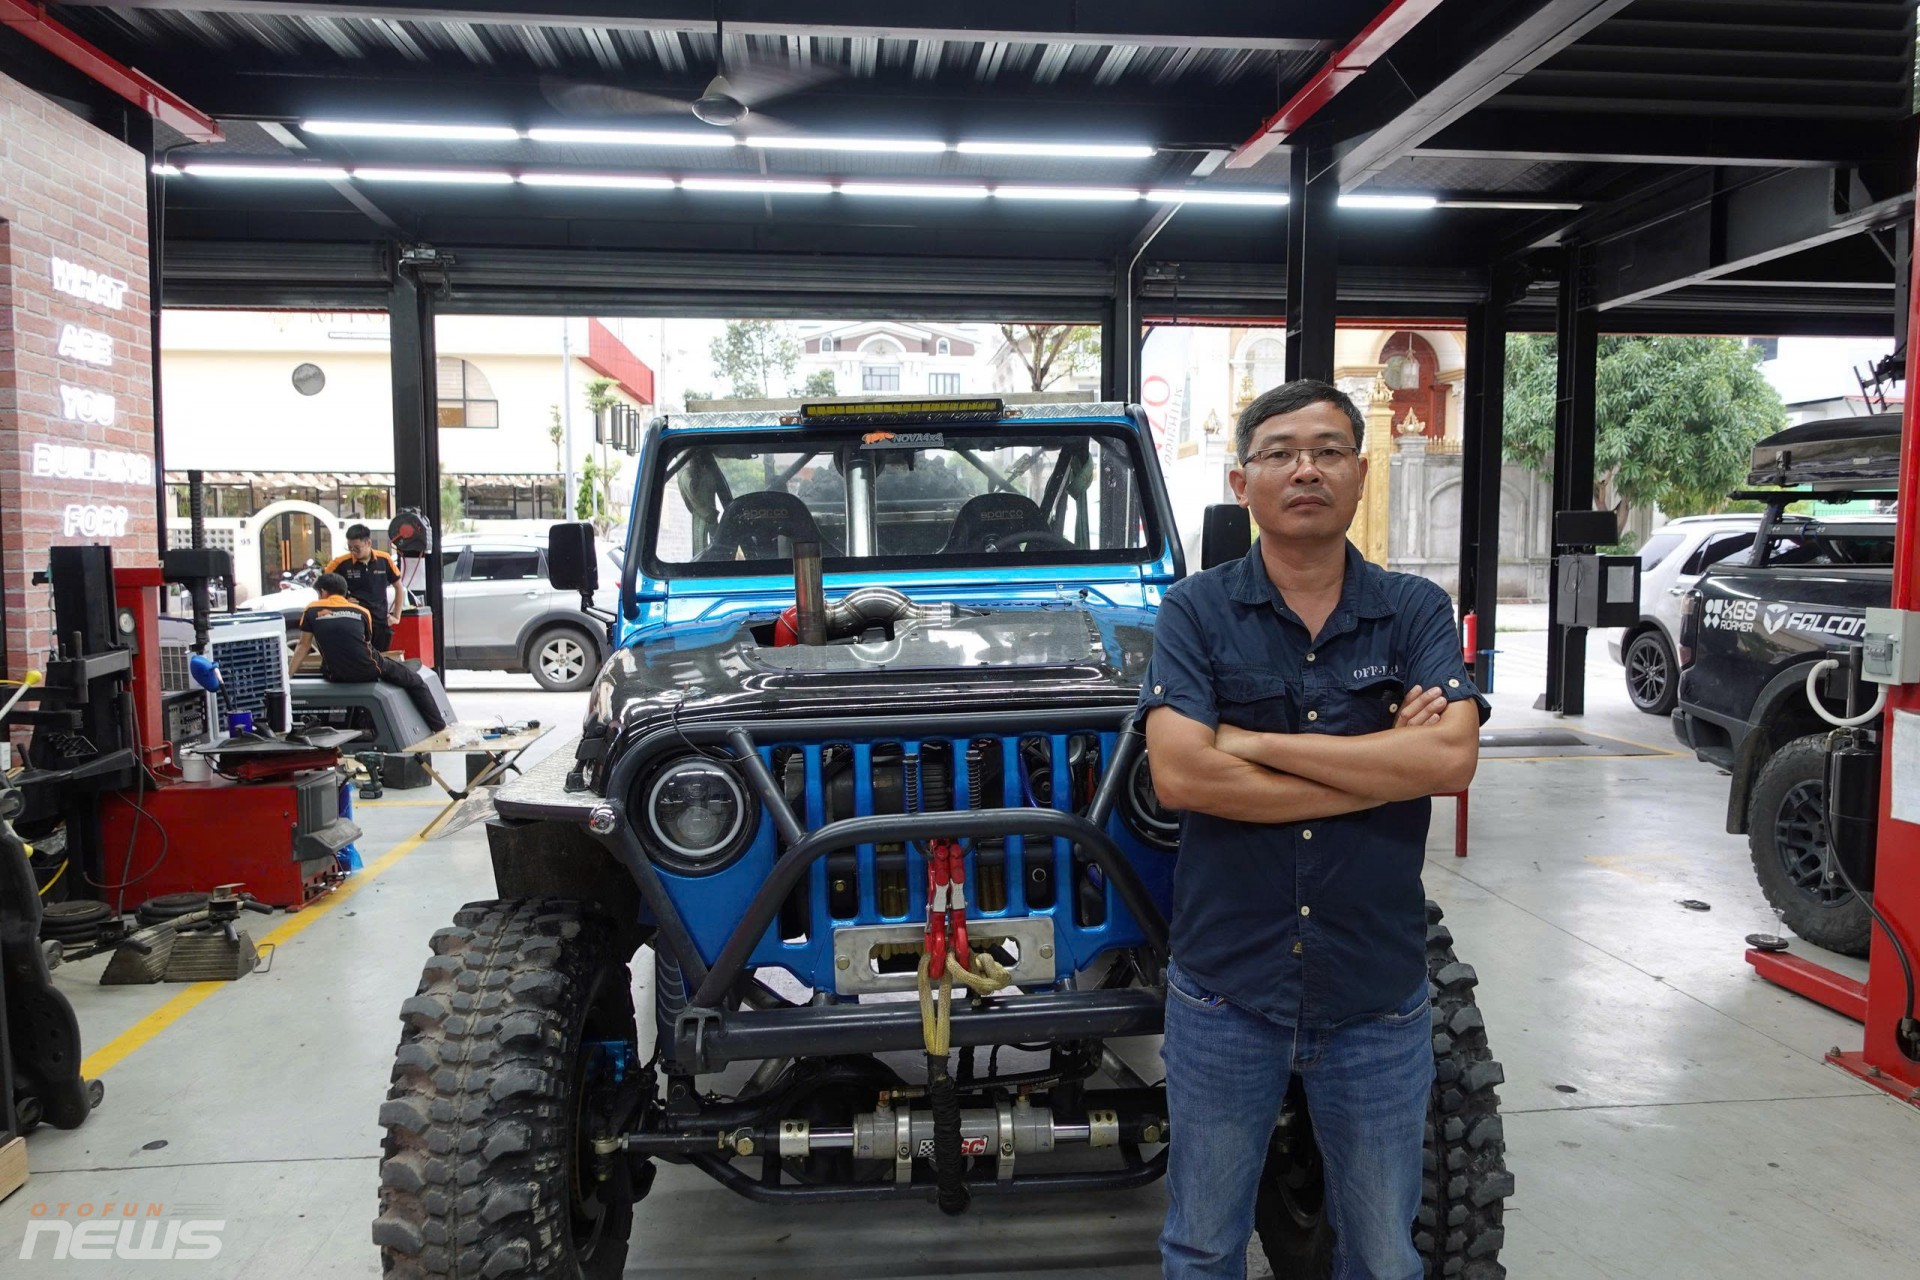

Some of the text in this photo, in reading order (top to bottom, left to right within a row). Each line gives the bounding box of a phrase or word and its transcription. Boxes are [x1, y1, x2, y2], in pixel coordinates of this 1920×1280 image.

[52, 256, 128, 310] WHAT
[58, 324, 114, 366] ARE
[60, 385, 115, 426] YOU
[33, 443, 151, 485] BUILDING
[1720, 620, 1754, 633] ROAMER
[1721, 600, 1758, 621] XGS
